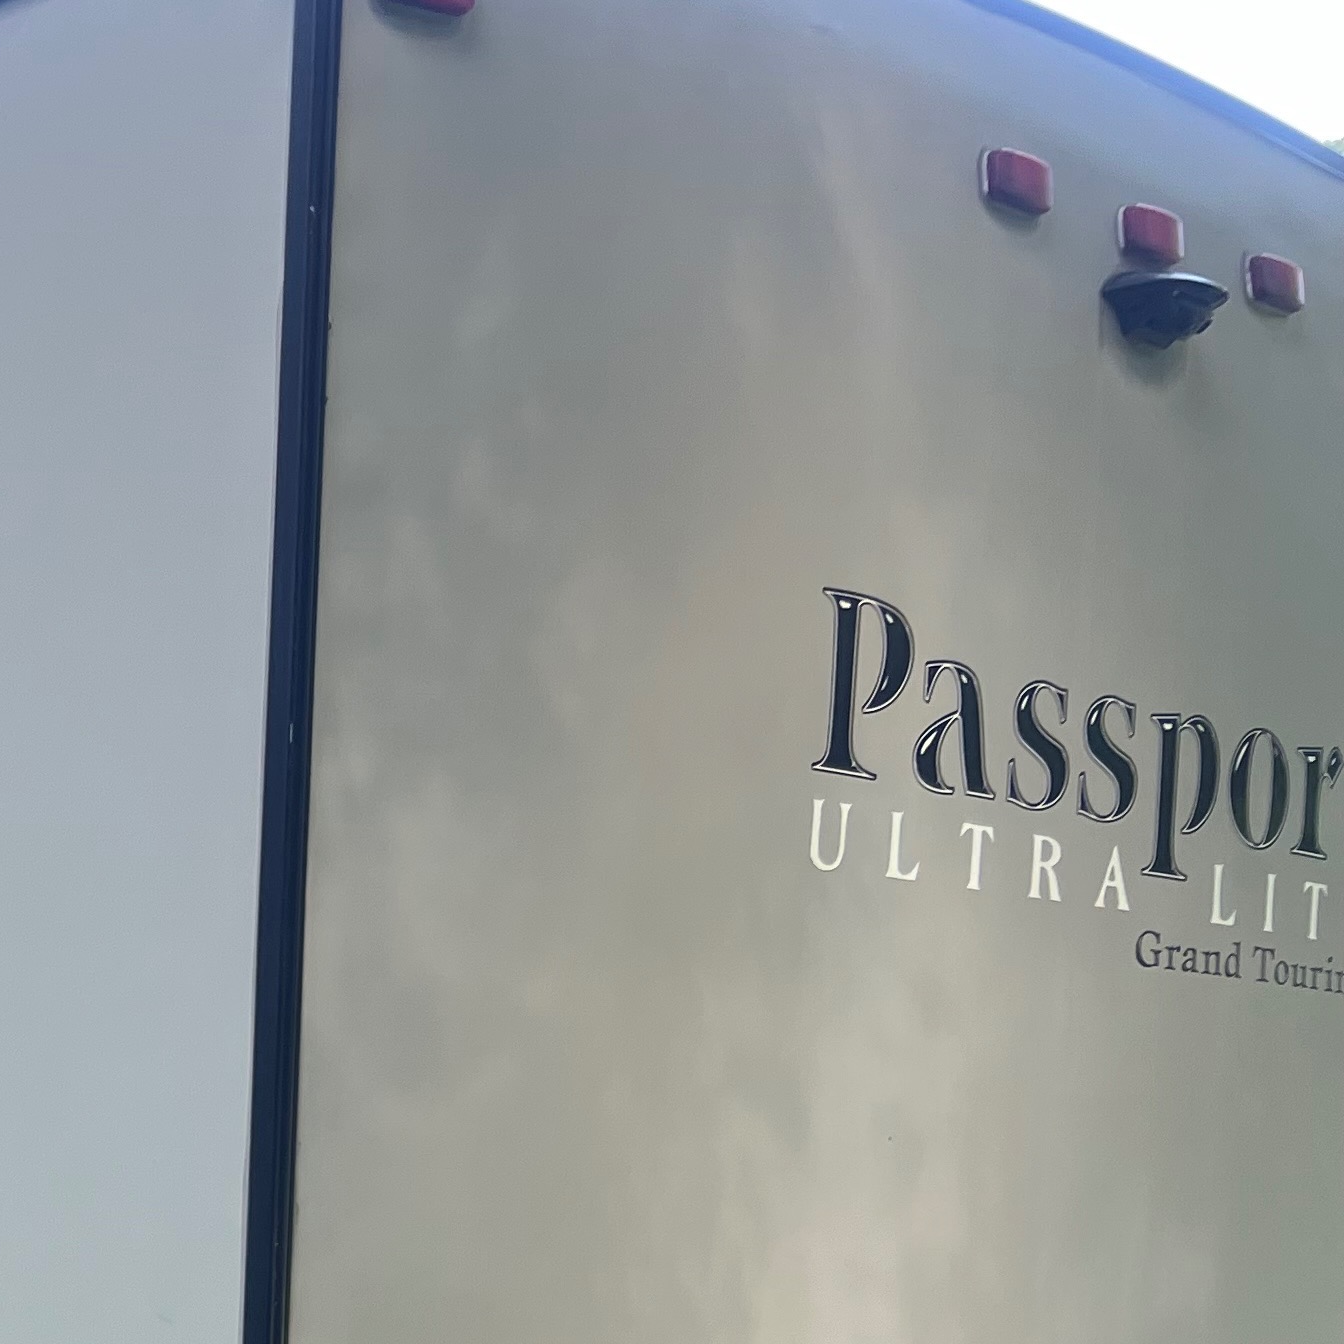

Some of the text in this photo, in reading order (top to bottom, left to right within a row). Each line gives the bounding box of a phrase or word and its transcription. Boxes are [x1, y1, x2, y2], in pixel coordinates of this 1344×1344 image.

[810, 586, 1344, 882] Passpor
[809, 798, 1329, 940] ULTRA LIT
[1135, 929, 1243, 979] Grand
